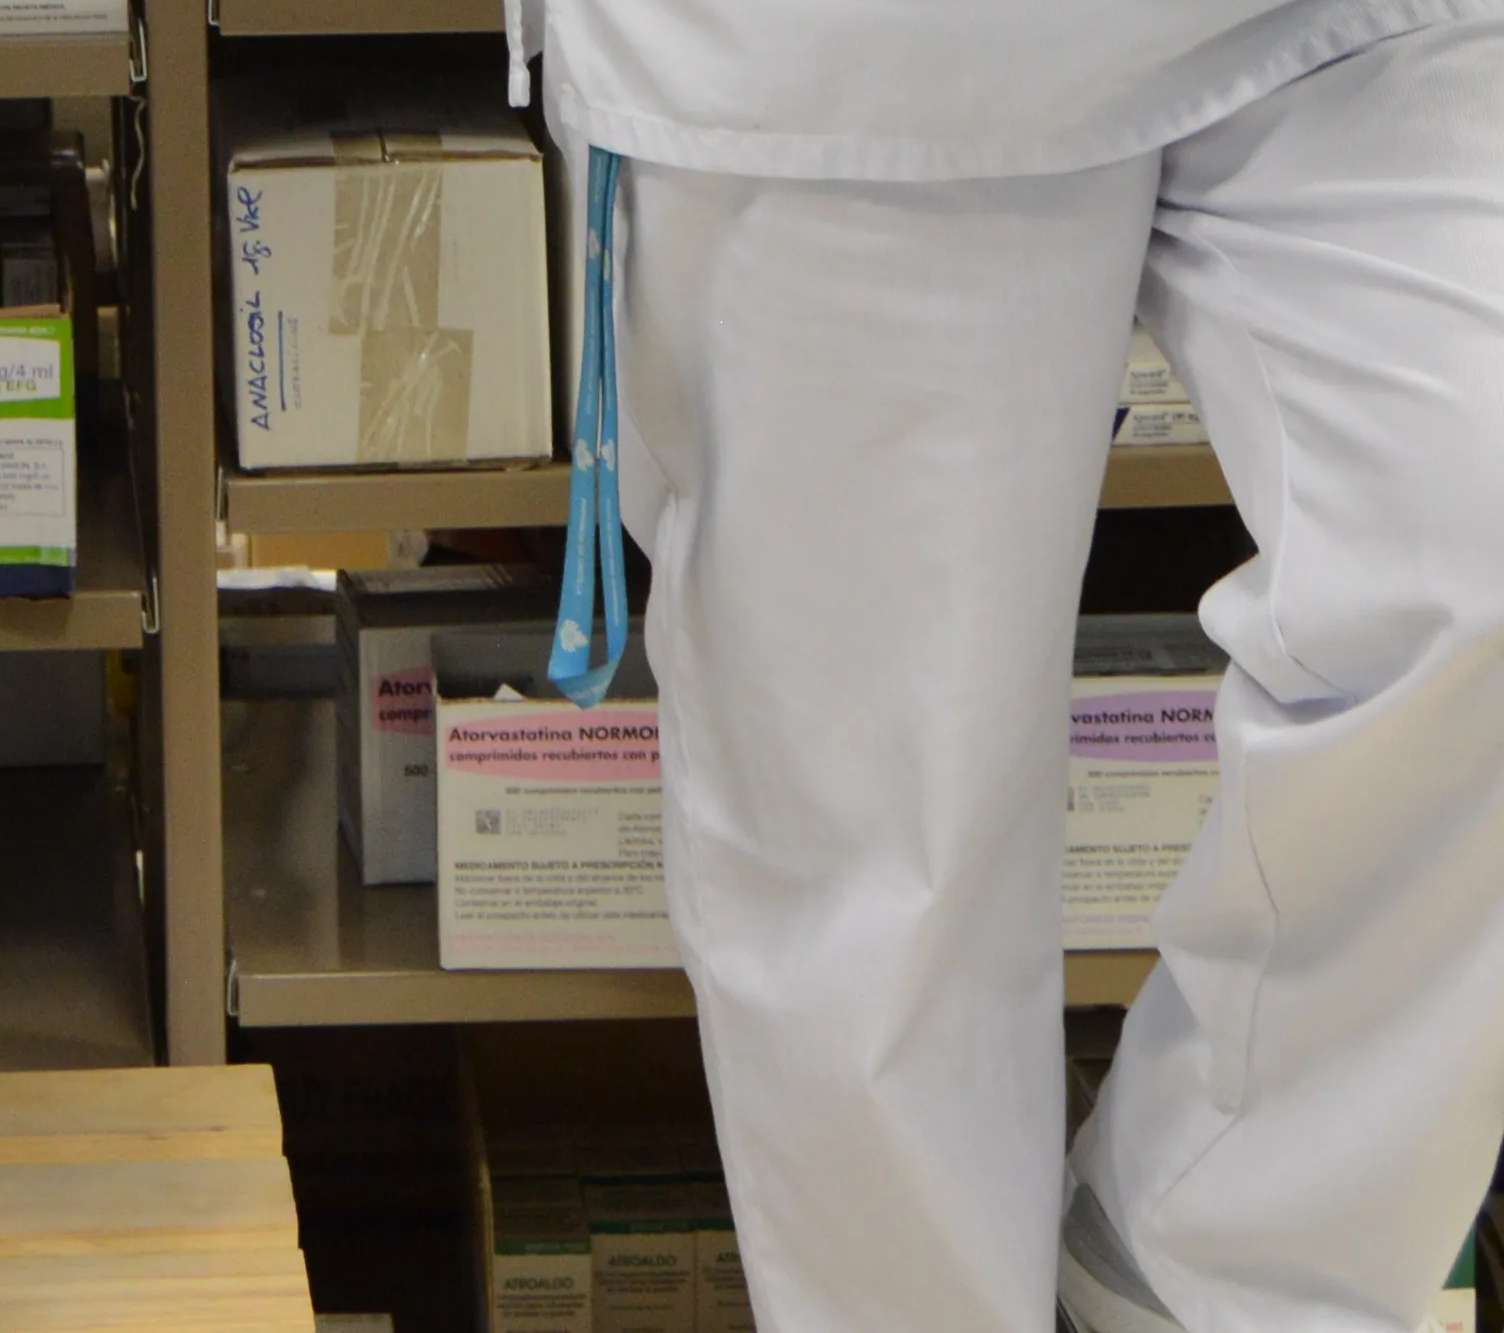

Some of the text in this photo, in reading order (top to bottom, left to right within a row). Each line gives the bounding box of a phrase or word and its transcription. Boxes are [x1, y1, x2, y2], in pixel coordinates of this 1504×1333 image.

[31, 361, 54, 380] ml
[4, 379, 38, 394] EFG
[449, 725, 659, 744] Atorvastatina NORMO
[1123, 729, 1197, 745] recubiertos
[449, 748, 647, 766] comprimidos recubiertos con
[607, 1252, 678, 1268] ATROALDO
